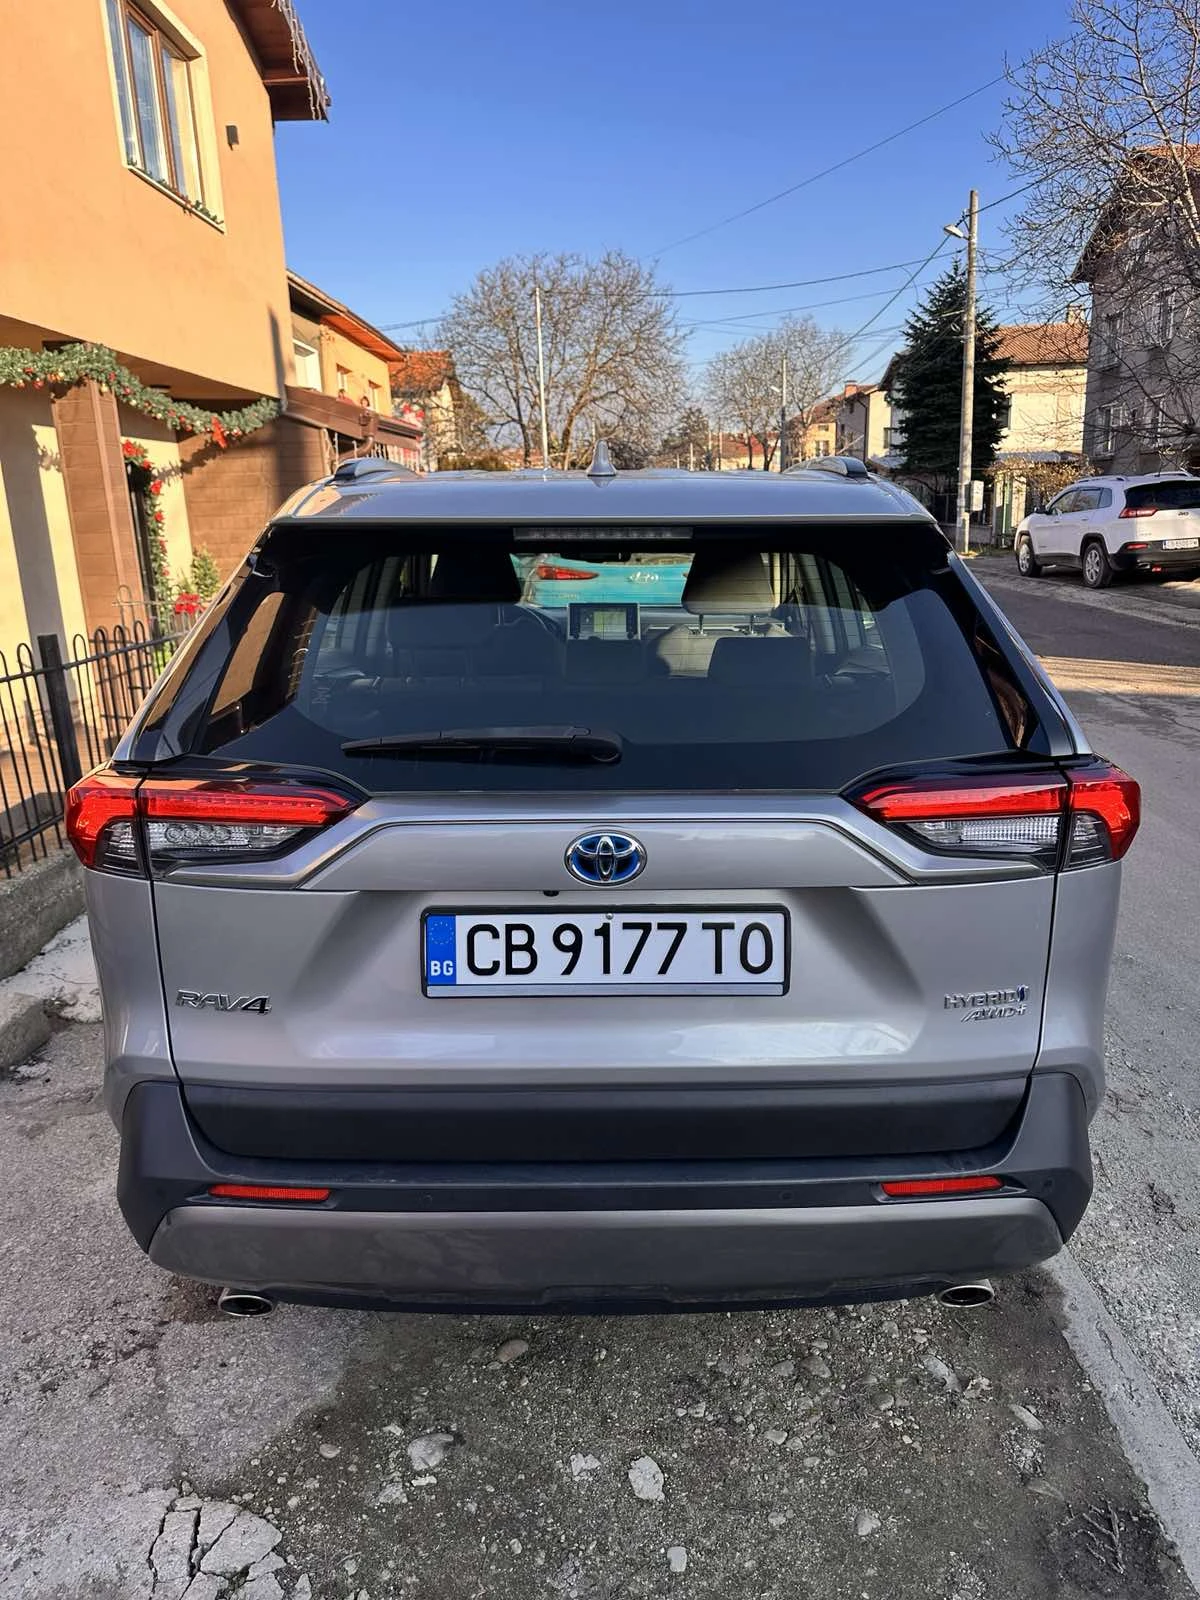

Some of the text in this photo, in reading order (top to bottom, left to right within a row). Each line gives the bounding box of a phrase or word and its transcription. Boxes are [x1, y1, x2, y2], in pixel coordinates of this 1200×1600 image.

[466, 922, 774, 976] CB 9177 TO
[430, 960, 454, 977] BG
[176, 989, 272, 1014] RAV4
[944, 990, 1017, 1010] HYBRID
